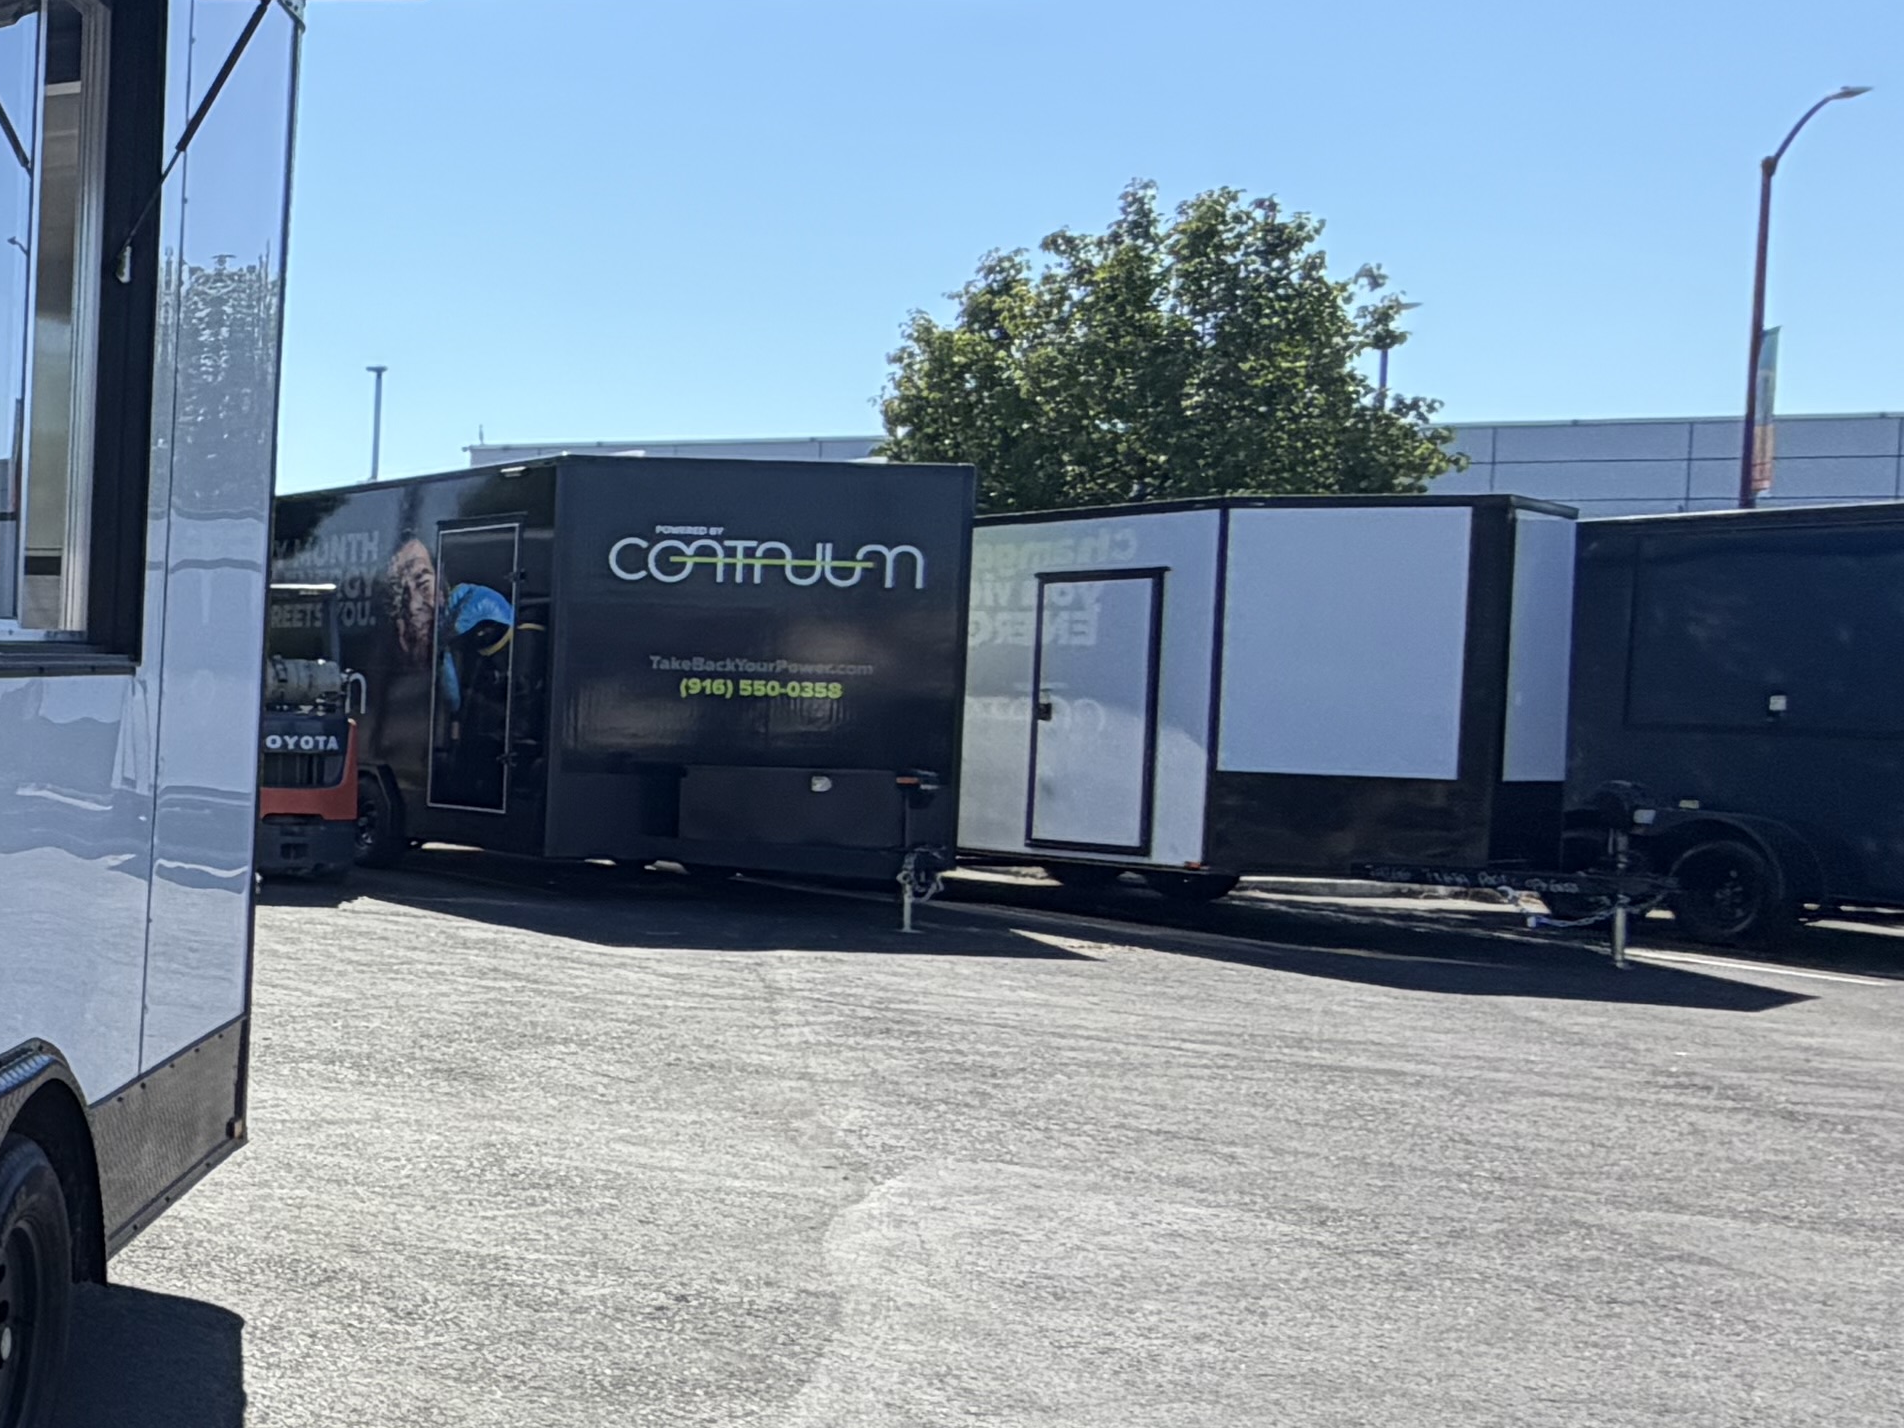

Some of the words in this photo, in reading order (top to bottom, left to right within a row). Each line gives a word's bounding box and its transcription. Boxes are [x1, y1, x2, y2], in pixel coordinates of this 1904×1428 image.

[709, 526, 724, 536] BY
[679, 678, 733, 698] (916)
[739, 679, 843, 699] 550-0358
